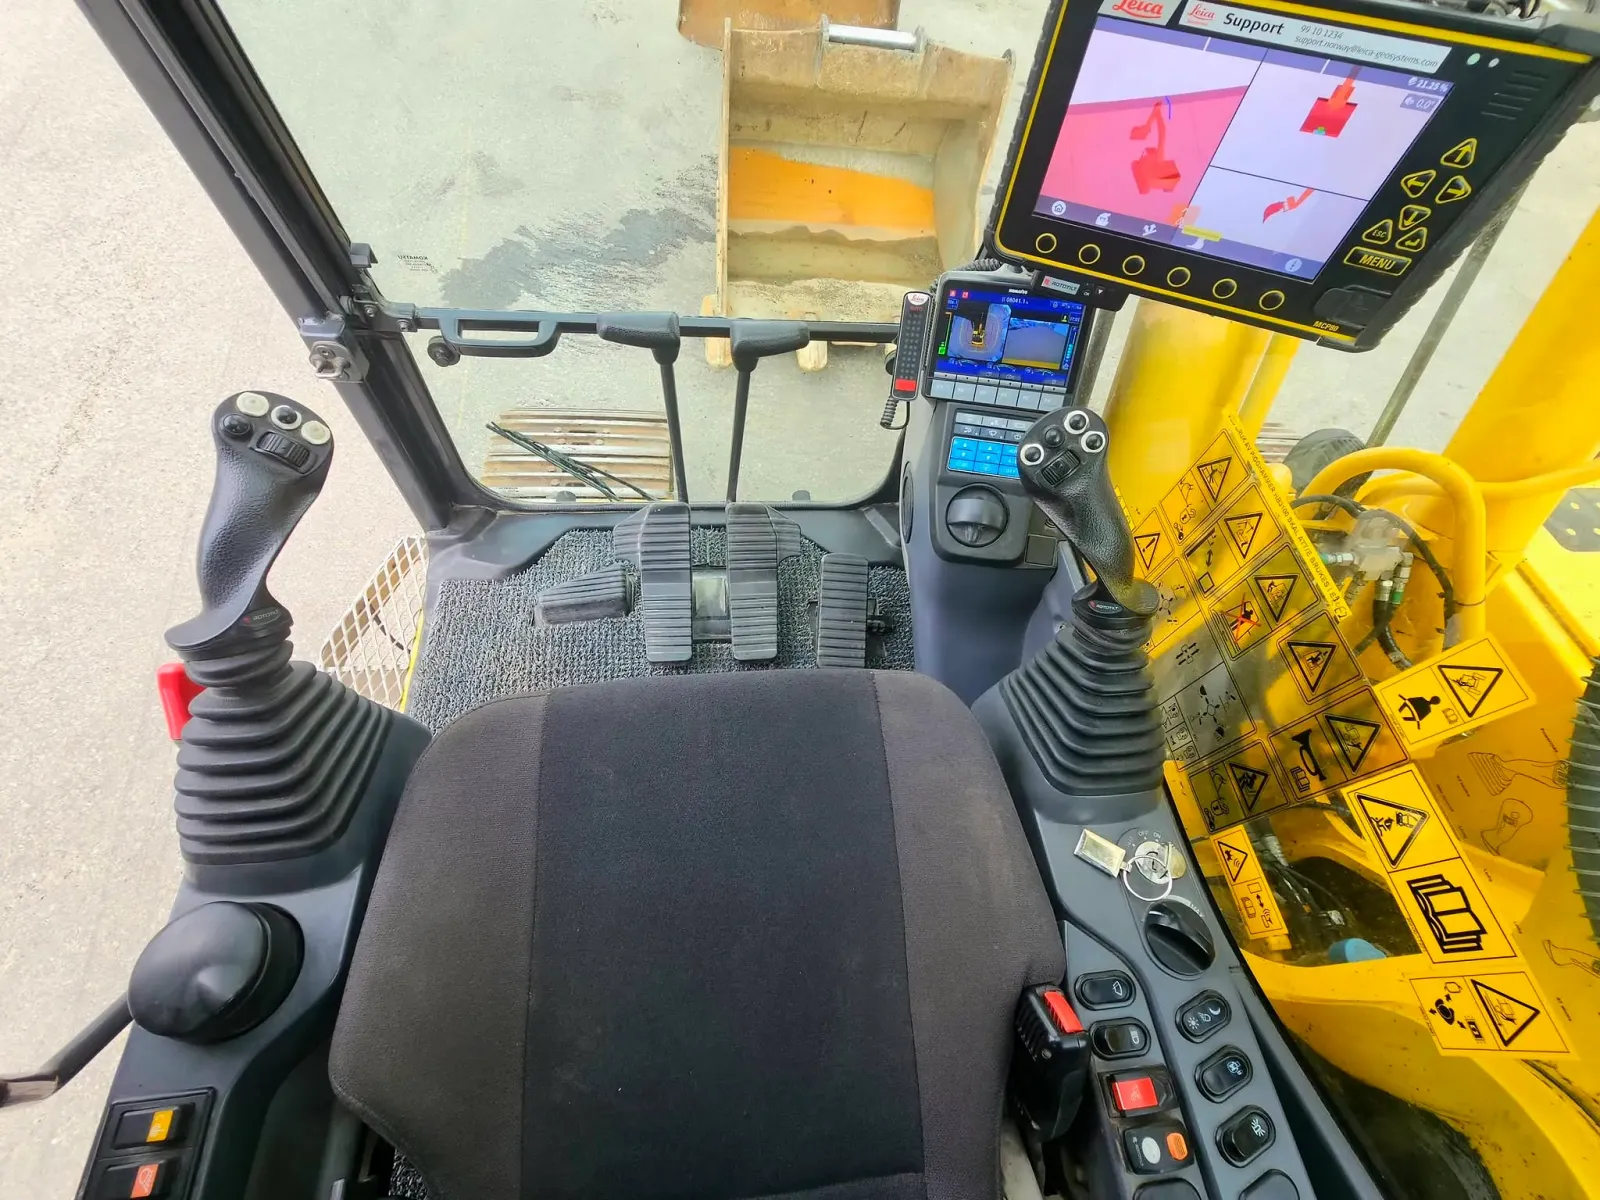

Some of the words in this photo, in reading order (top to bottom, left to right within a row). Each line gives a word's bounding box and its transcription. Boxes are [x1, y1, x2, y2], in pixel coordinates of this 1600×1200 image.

[1112, 0, 1164, 19] Leica
[1188, 4, 1216, 20] Leica
[1223, 12, 1285, 35] Support
[1300, 25, 1310, 33] 99
[1312, 27, 1323, 36] 10
[1324, 29, 1345, 40] 1234
[1294, 36, 1439, 67] support.norway@leica-geosystems.com
[1372, 229, 1387, 238] ESC
[1359, 254, 1397, 270] MENU
[1313, 320, 1340, 332] MCP80
[1286, 516, 1301, 537] SKAL
[1308, 556, 1332, 588] BRUKES
